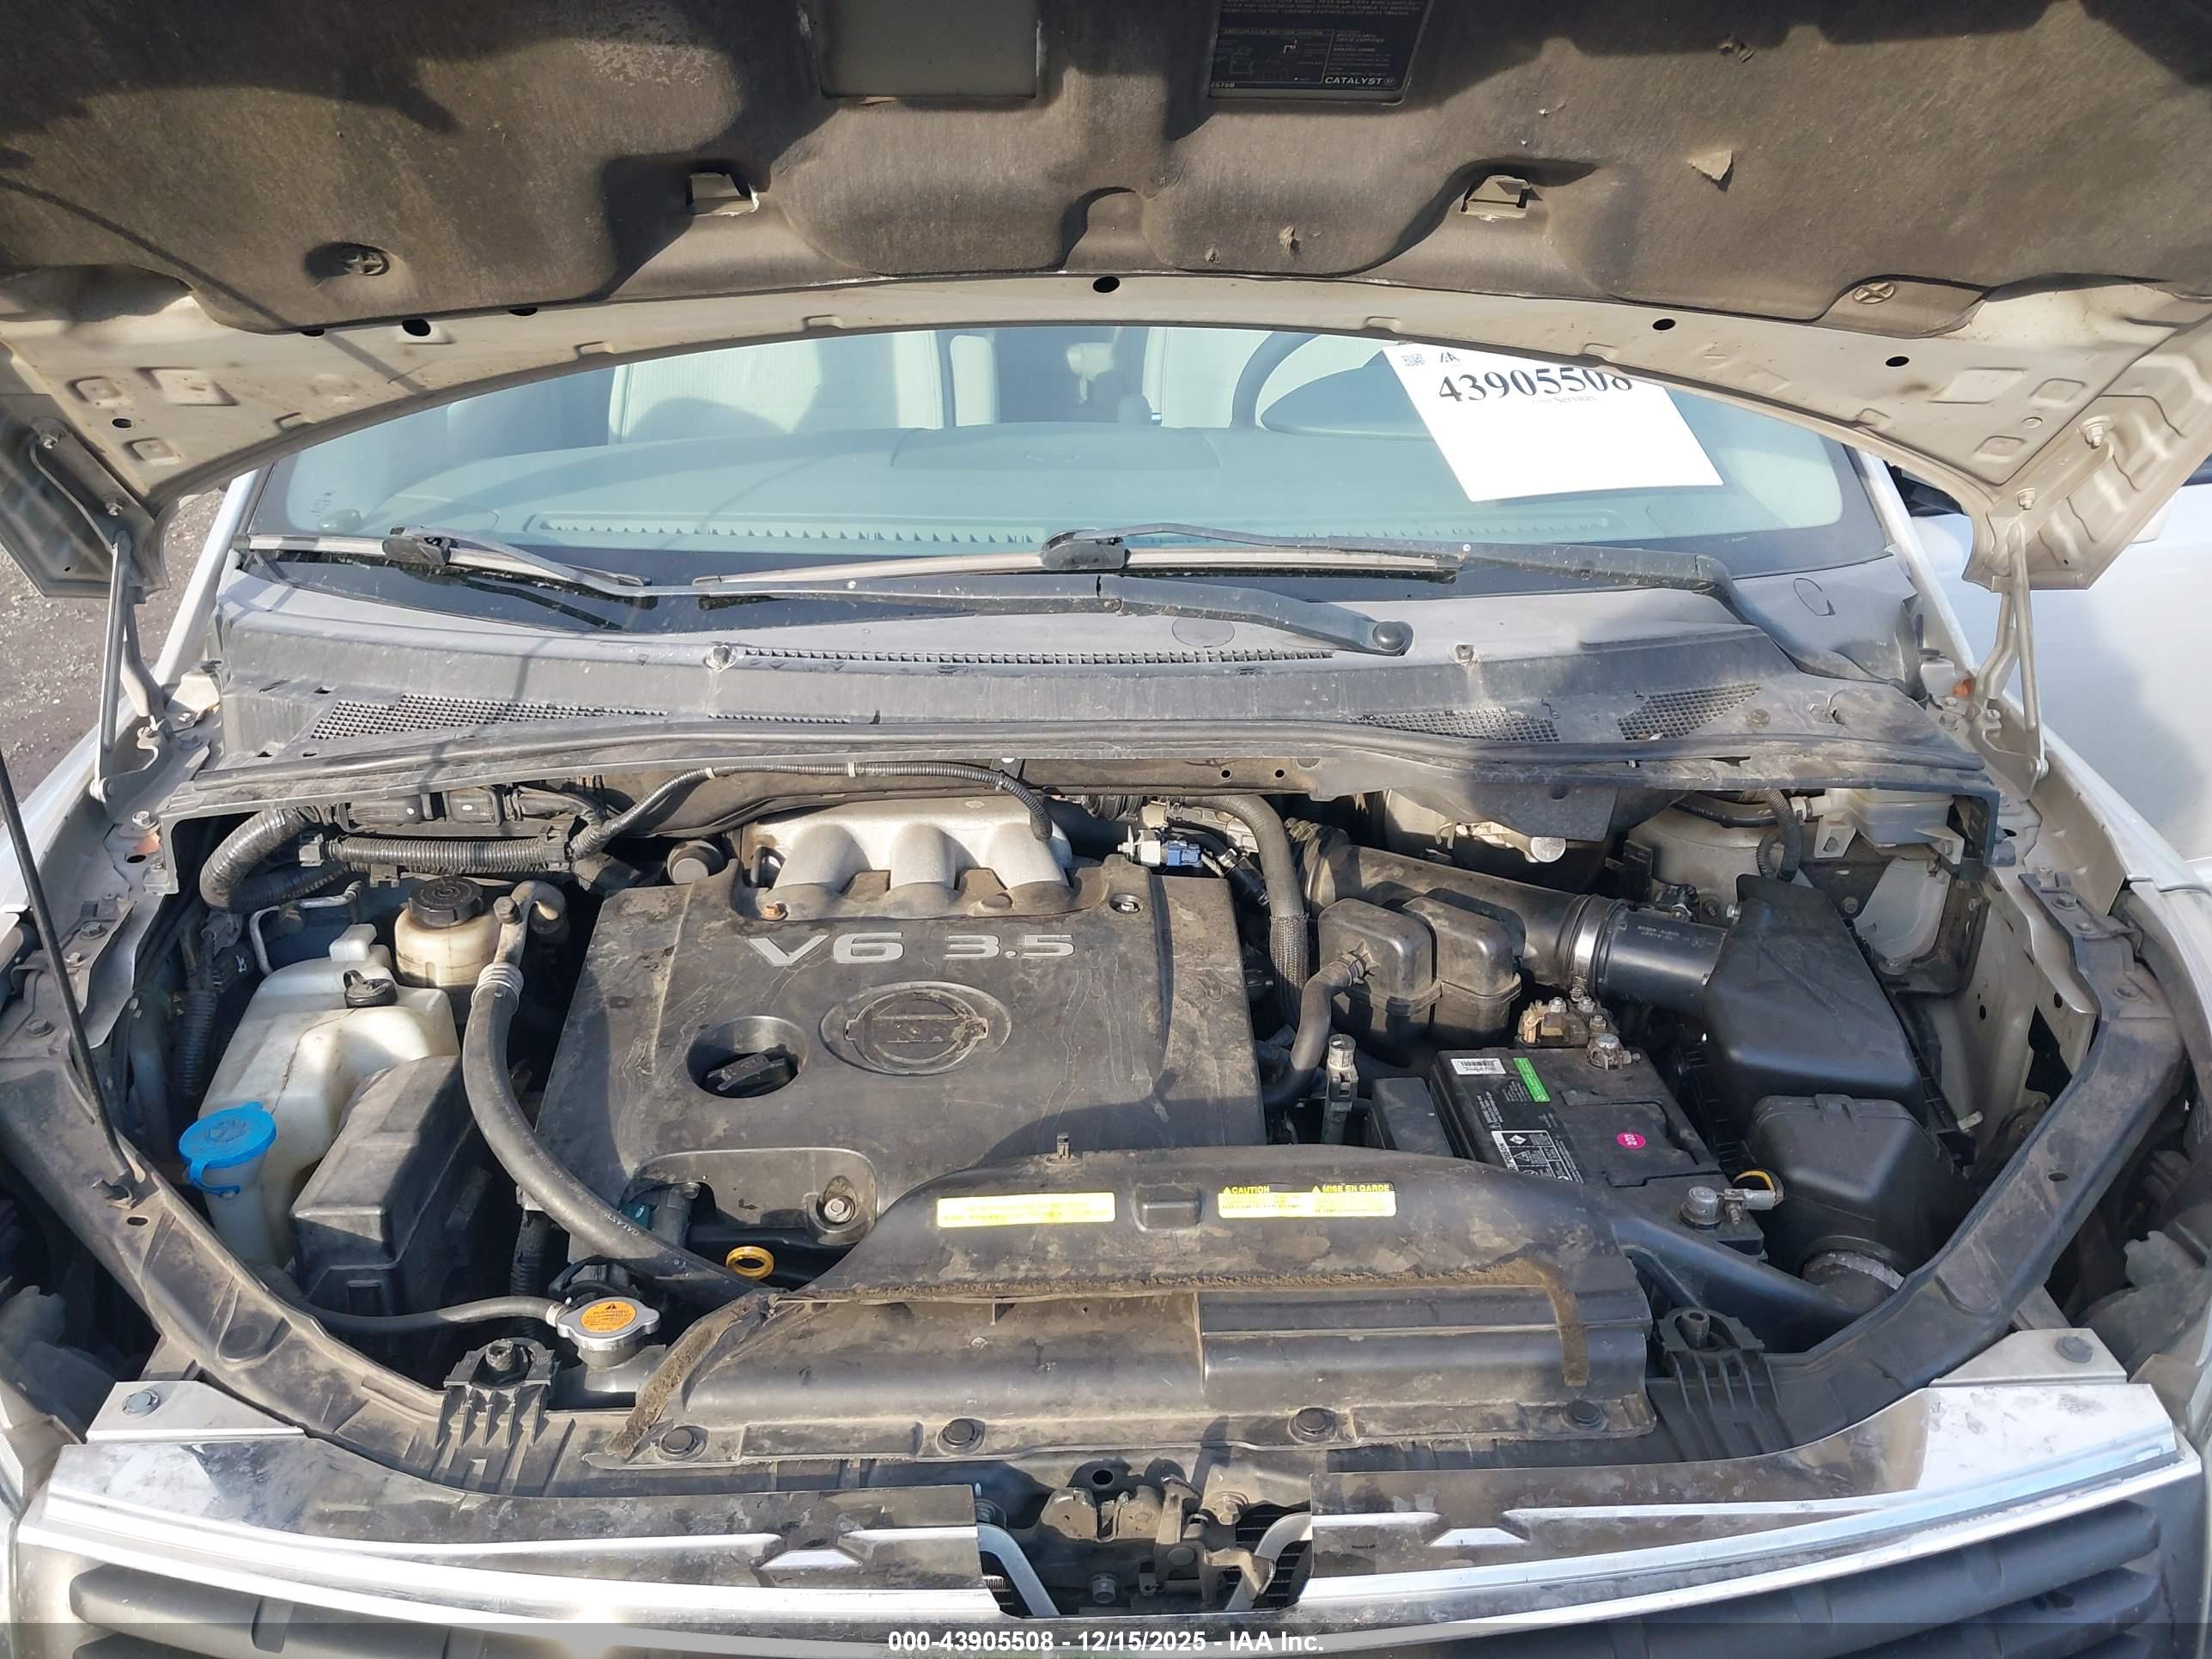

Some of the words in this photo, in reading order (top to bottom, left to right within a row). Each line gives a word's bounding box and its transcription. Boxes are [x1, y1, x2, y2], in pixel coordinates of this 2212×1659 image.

[1325, 76, 1382, 85] CATALYST
[747, 931, 905, 967] V6
[943, 933, 1076, 960] 3.5
[1231, 1185, 1270, 1194] CAUTION
[1322, 1184, 1344, 1193] MISE
[1345, 1184, 1357, 1193] EN
